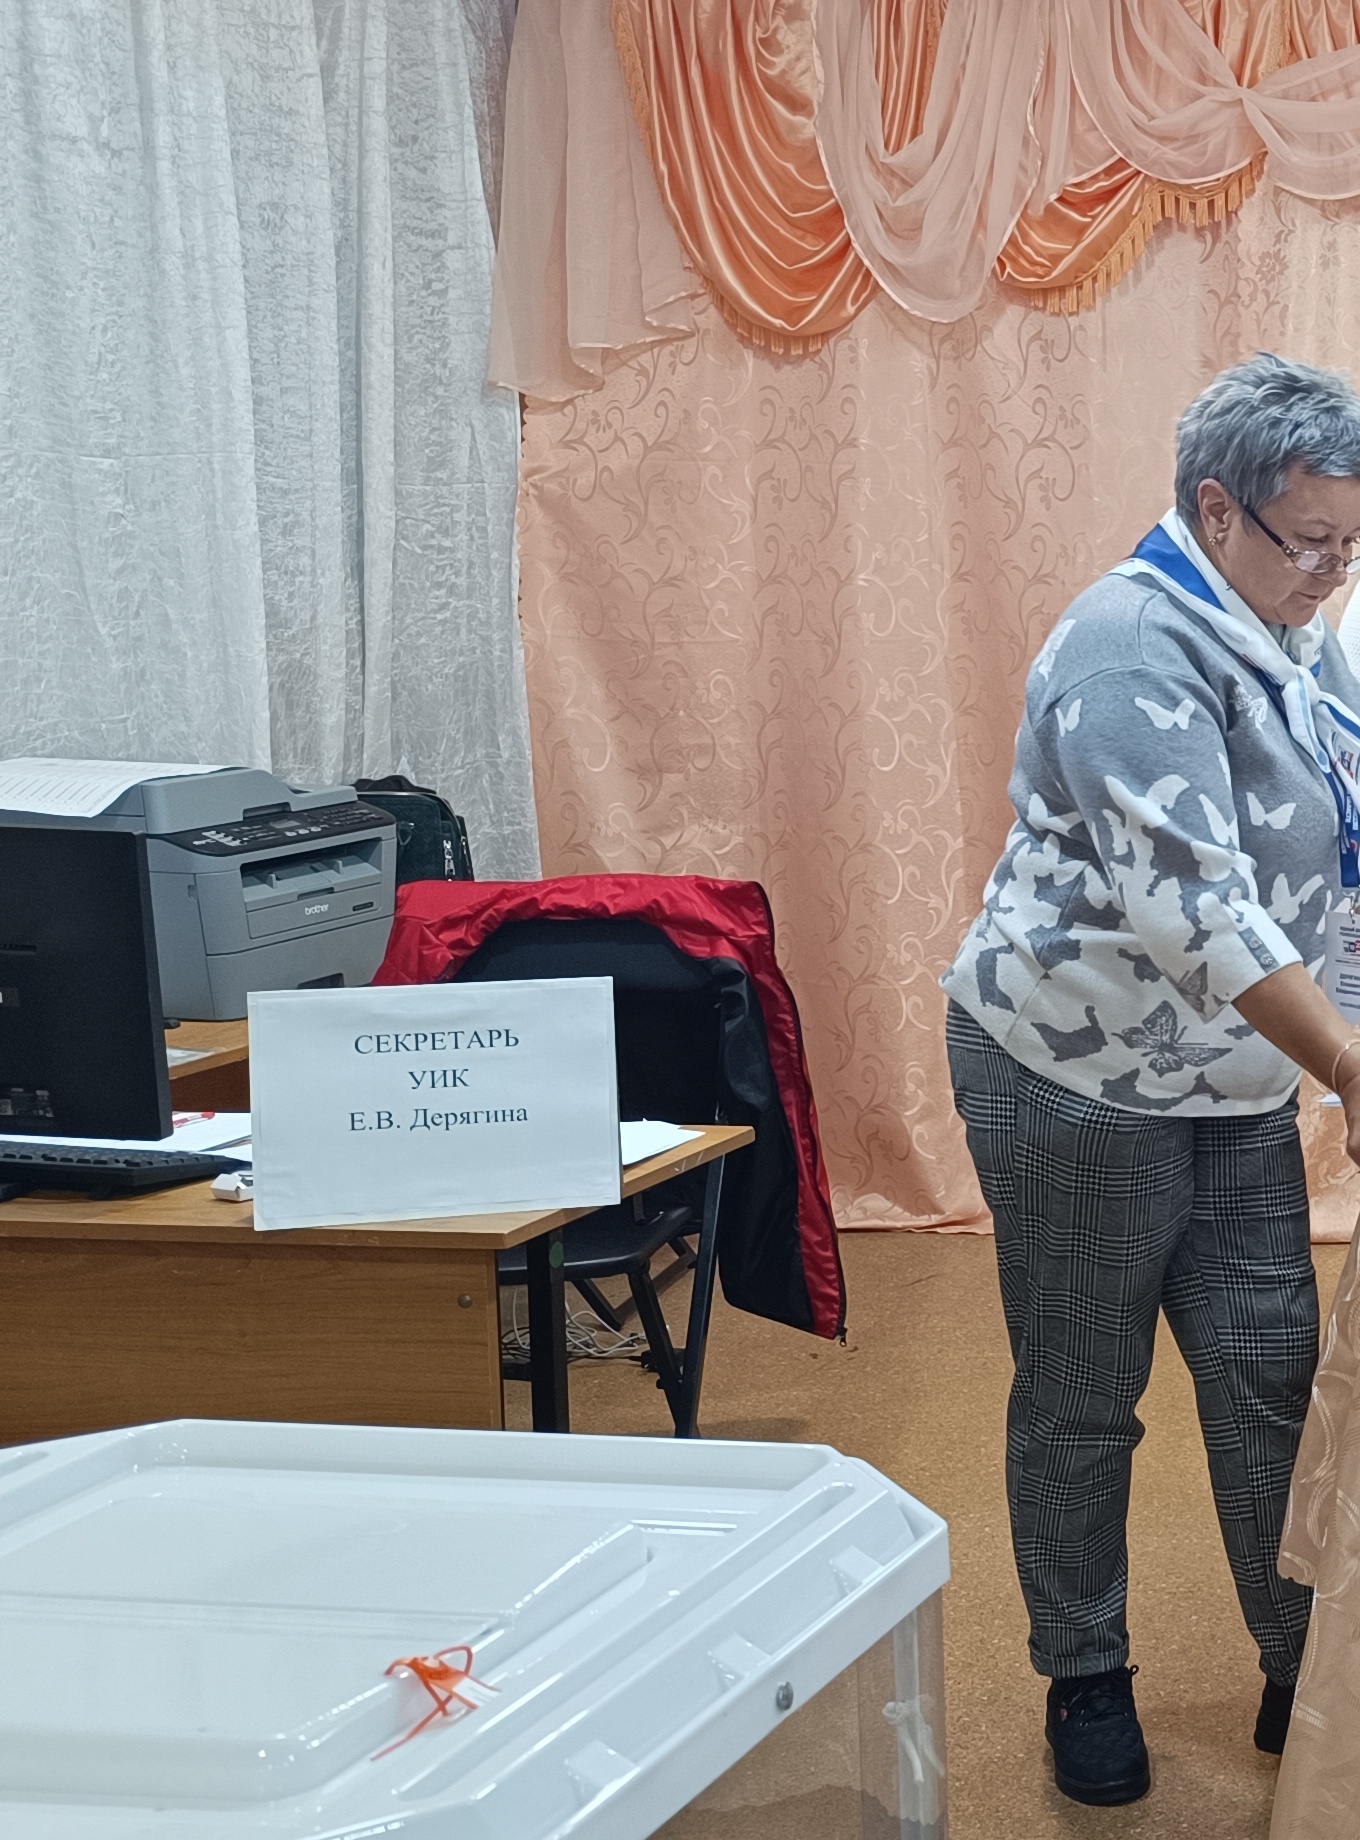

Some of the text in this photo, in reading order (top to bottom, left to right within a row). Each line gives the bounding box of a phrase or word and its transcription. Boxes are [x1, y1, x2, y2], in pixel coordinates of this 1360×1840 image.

[354, 1028, 520, 1055] СЕКРЕТАРЬ
[408, 1068, 470, 1090] УИК
[348, 1107, 529, 1131] Е.В. Дерягина
